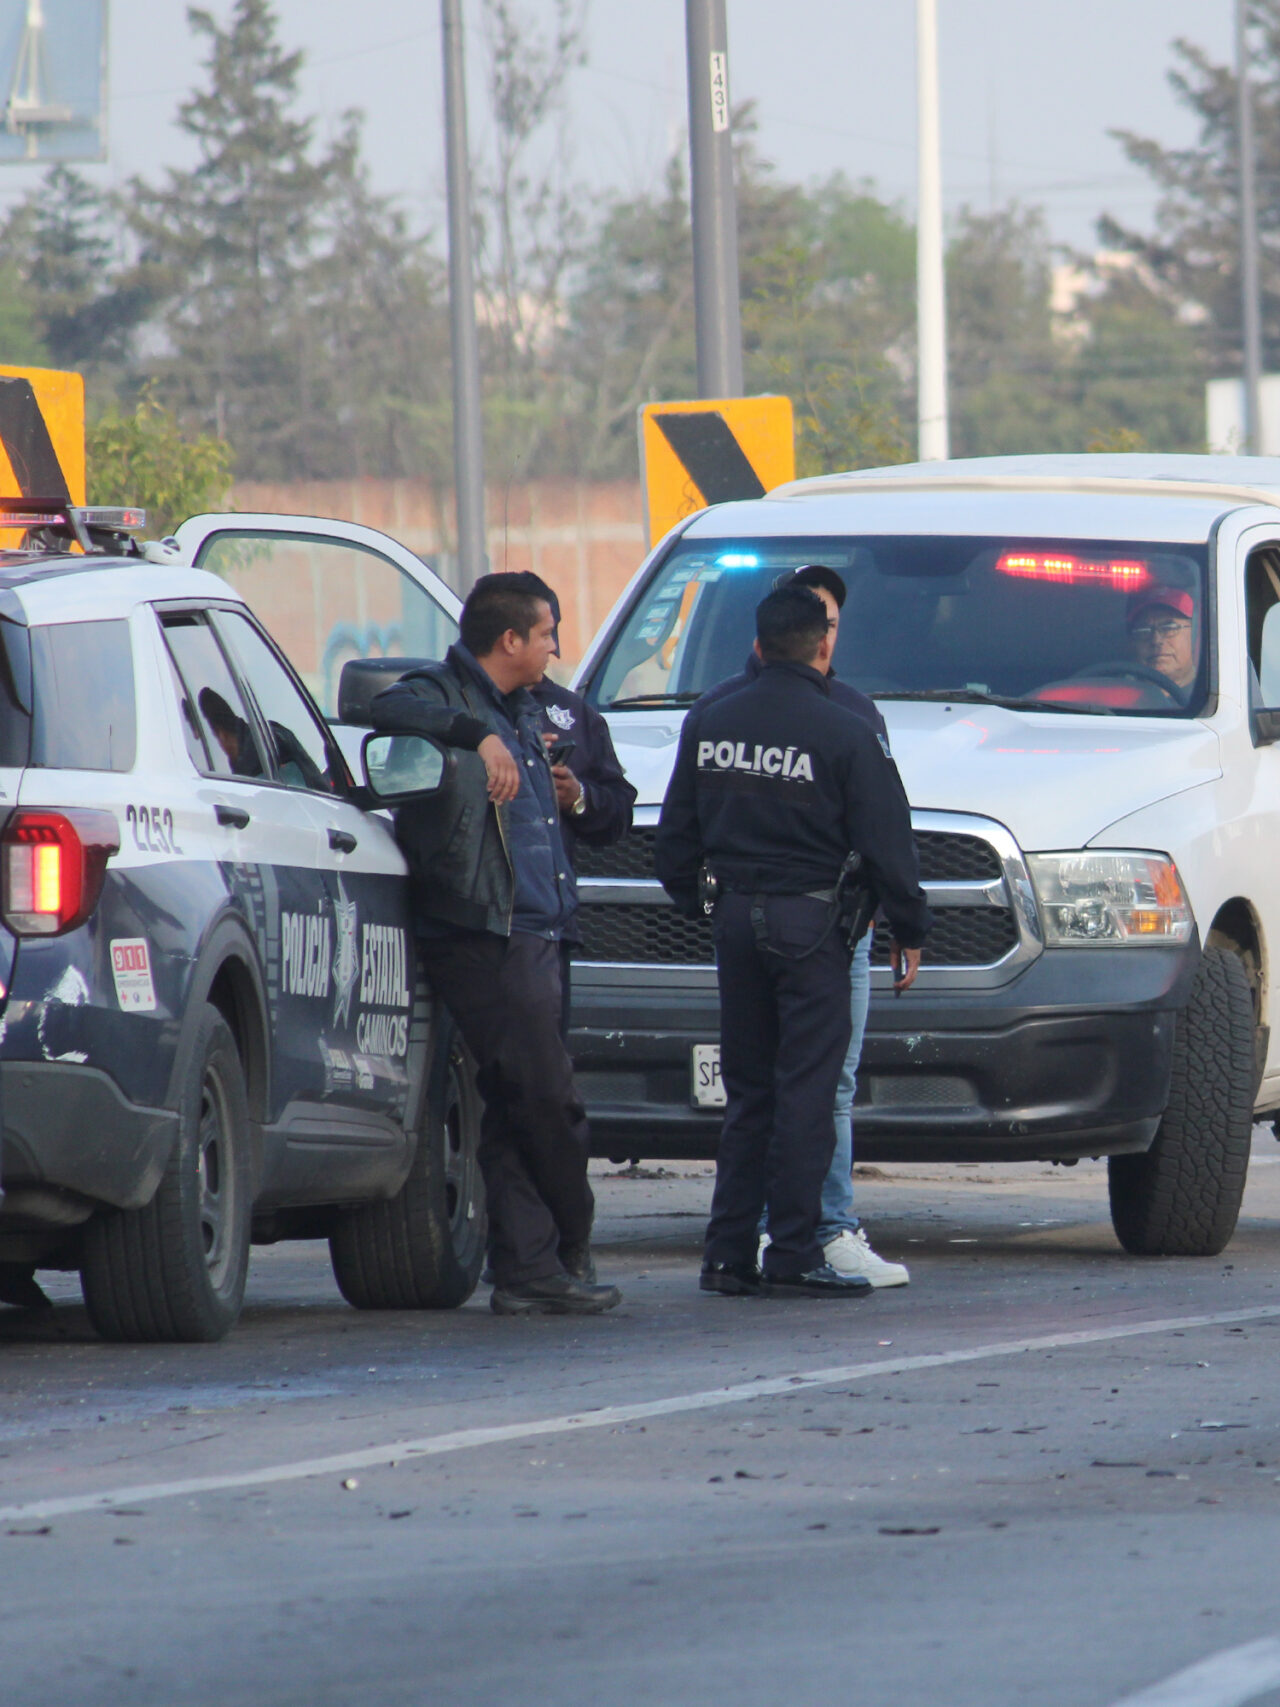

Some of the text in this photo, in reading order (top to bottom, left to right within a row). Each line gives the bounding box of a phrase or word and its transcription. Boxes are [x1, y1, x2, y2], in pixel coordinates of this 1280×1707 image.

[714, 55, 724, 123] 1431
[697, 741, 814, 781] POLICÍA
[126, 804, 184, 855] 2252
[114, 947, 146, 970] 911
[360, 923, 410, 1007] ESTATAL
[357, 1012, 408, 1057] CAMINOS
